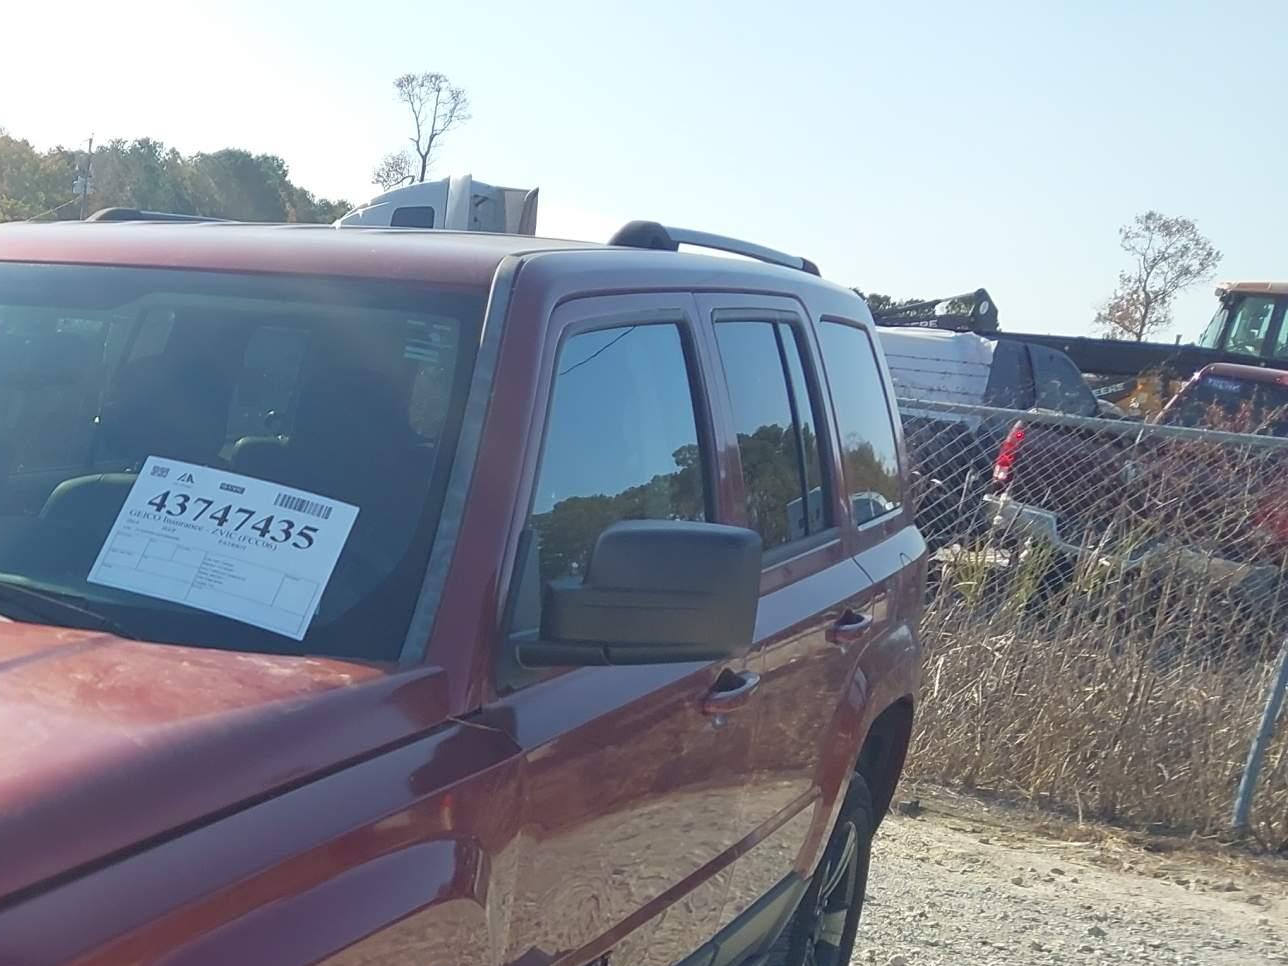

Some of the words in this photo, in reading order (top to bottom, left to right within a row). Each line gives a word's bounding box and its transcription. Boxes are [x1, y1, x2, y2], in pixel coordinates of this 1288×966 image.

[1092, 382, 1125, 397] EERE
[129, 509, 161, 522] GEICO
[163, 515, 204, 532] Insurance
[147, 490, 320, 550] 43747435
